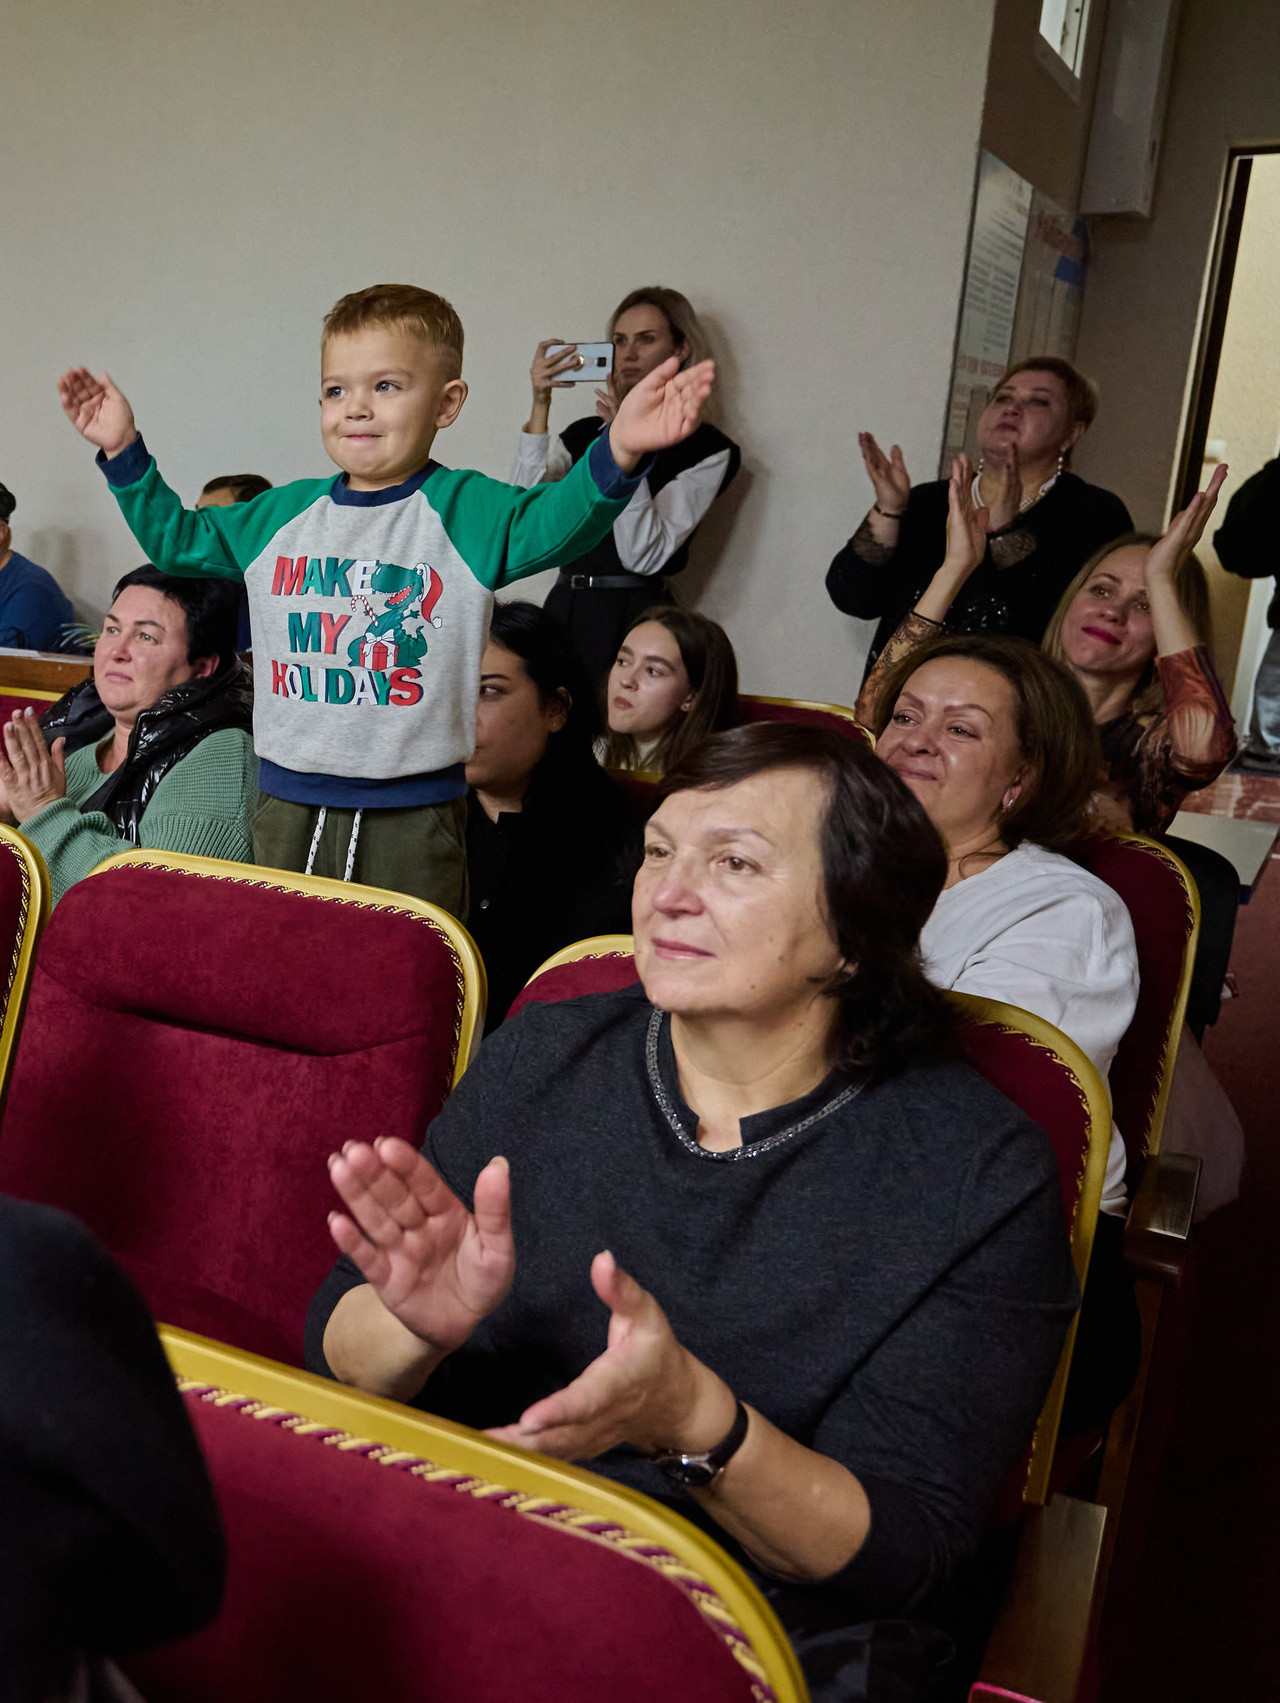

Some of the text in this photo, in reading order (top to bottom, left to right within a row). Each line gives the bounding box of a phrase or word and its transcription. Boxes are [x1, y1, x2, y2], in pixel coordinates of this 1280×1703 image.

[271, 556, 379, 597] MAKE
[288, 612, 352, 654] MY
[271, 660, 424, 706] HOLIDAYS
